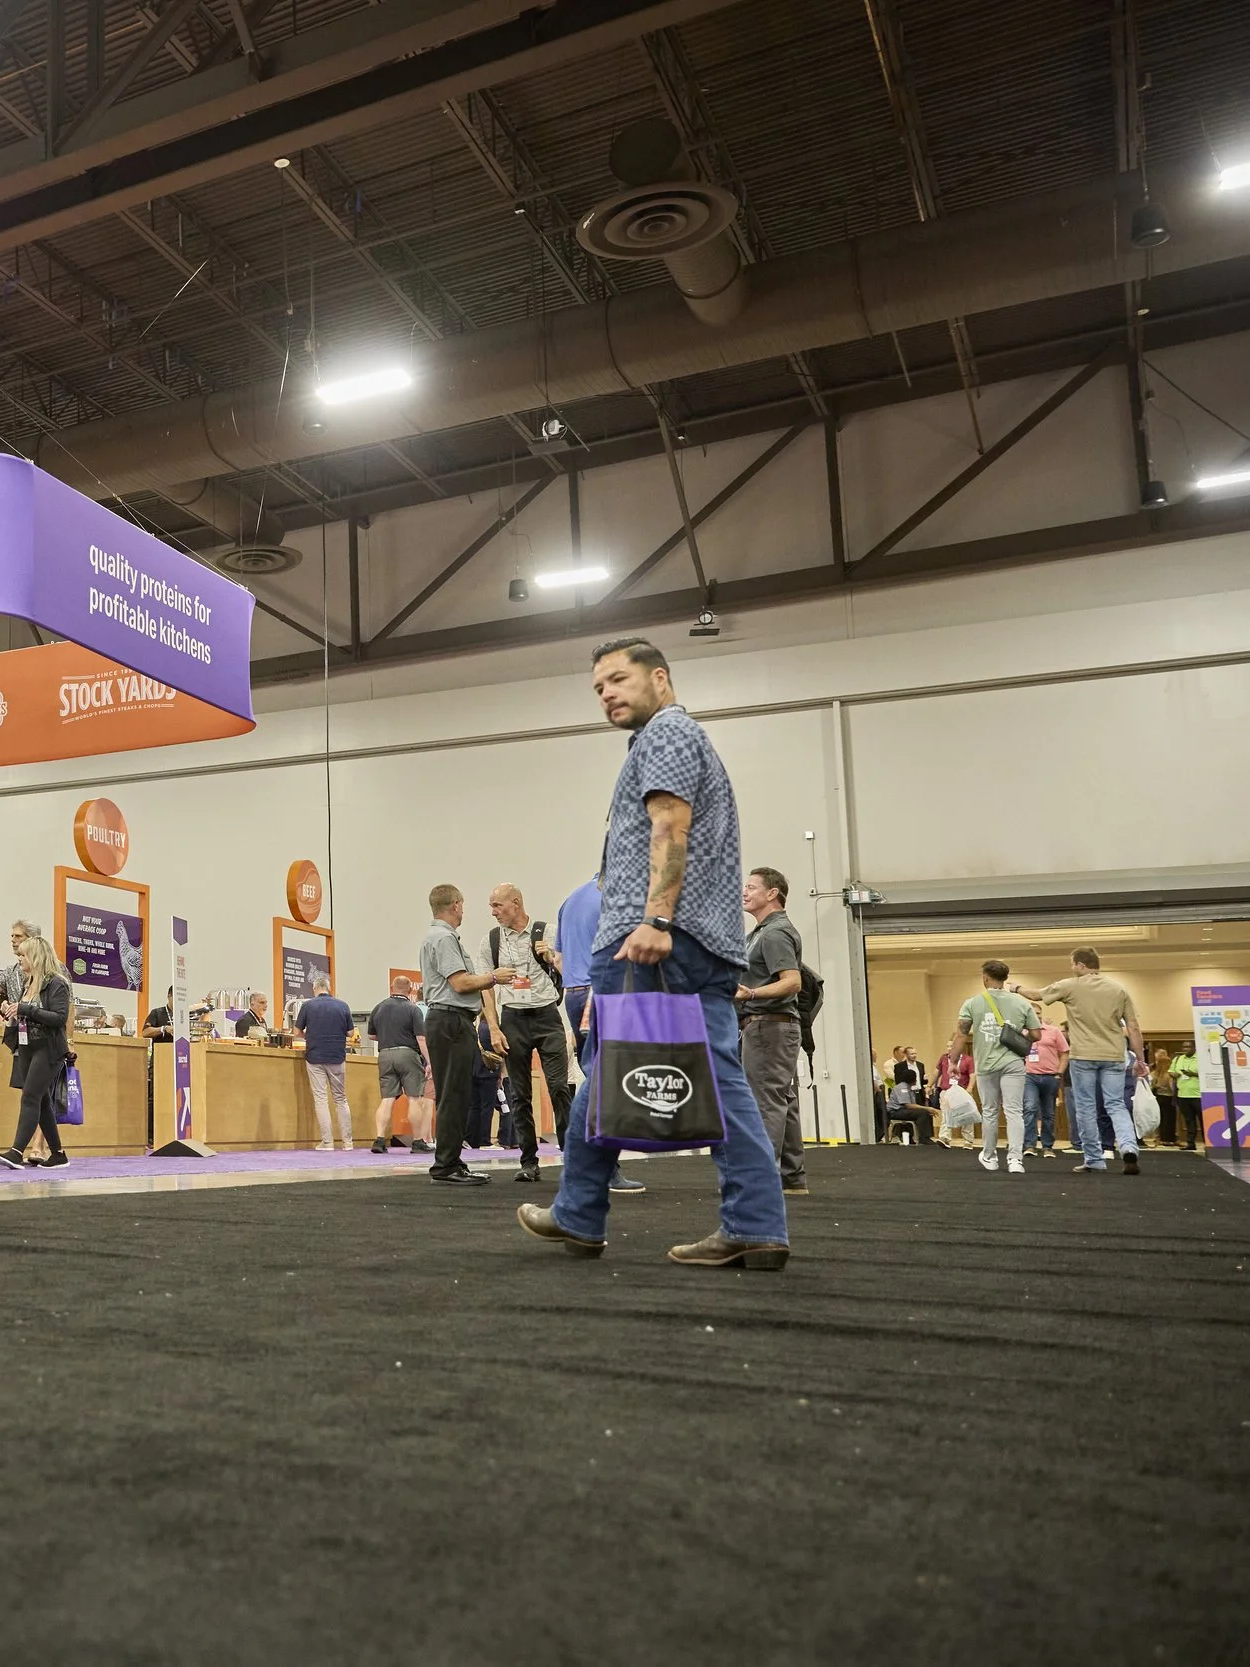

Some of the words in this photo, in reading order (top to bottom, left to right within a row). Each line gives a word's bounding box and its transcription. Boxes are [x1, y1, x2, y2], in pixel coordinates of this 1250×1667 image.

[89, 544, 138, 594] quality
[141, 572, 192, 616] proteins
[194, 595, 211, 625] for
[90, 587, 157, 640] profitable
[159, 617, 211, 664] kitchens
[96, 670, 118, 679] SINCE
[59, 679, 114, 717] STOCK
[74, 711, 98, 721] WORLD'S
[87, 824, 126, 849] POULTRY
[302, 883, 316, 899] BEEF
[634, 1072, 684, 1092] Taylor
[646, 1091, 677, 1101] FARMS
